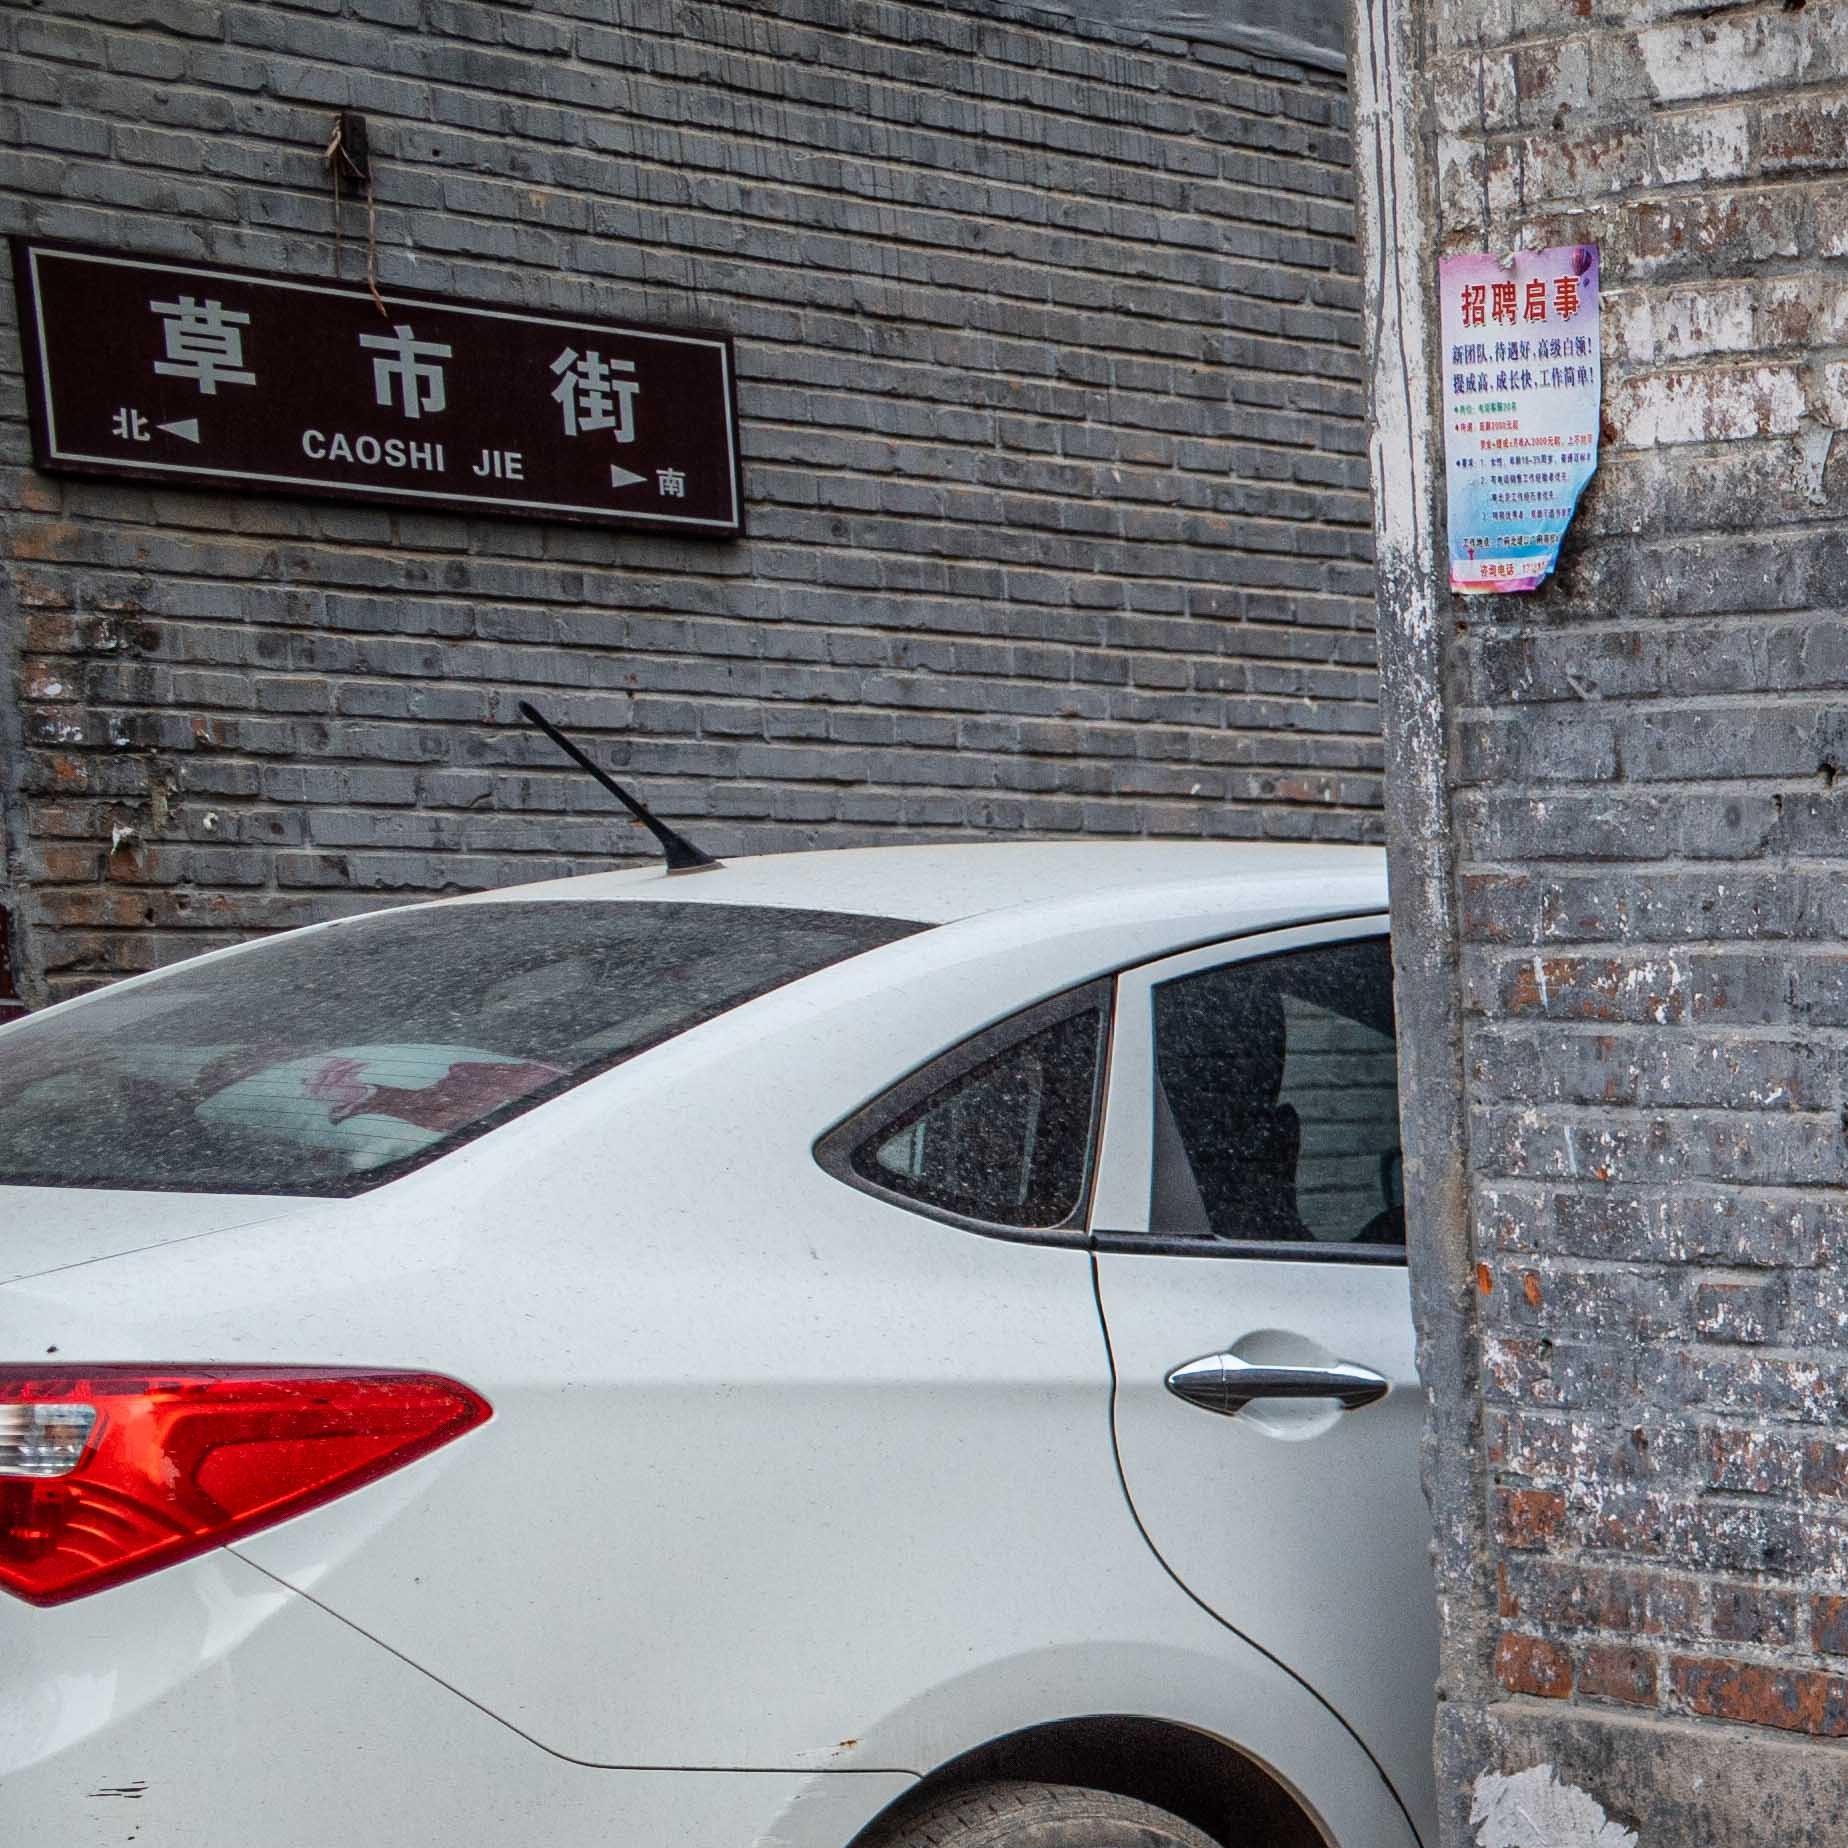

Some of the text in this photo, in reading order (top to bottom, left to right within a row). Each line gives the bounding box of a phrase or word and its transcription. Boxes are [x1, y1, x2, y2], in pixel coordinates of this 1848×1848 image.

[1460, 276, 1580, 328] 招聘启事
[149, 295, 642, 444] 草市街
[112, 407, 152, 443] 北
[301, 429, 525, 480] CAOSHI JIE
[656, 467, 686, 498] 南
